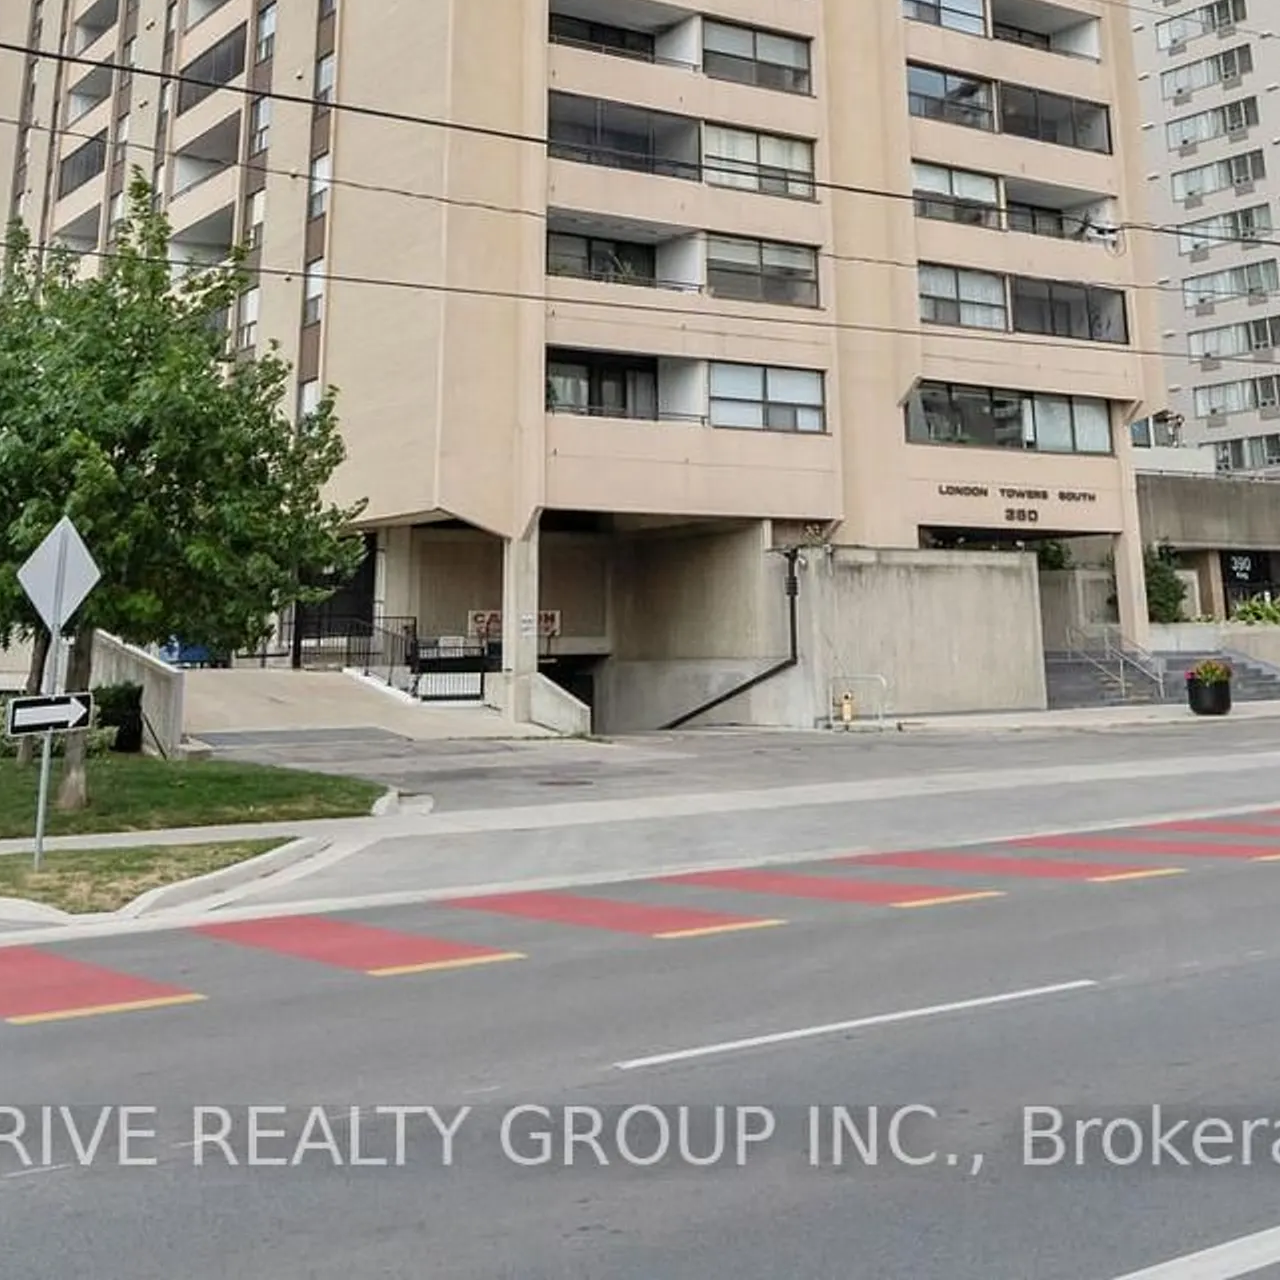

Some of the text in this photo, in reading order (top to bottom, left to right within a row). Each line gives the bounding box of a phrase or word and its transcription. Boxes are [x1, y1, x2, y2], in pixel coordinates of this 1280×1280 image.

[938, 484, 1096, 502] LONDON TOWERS SOUTH
